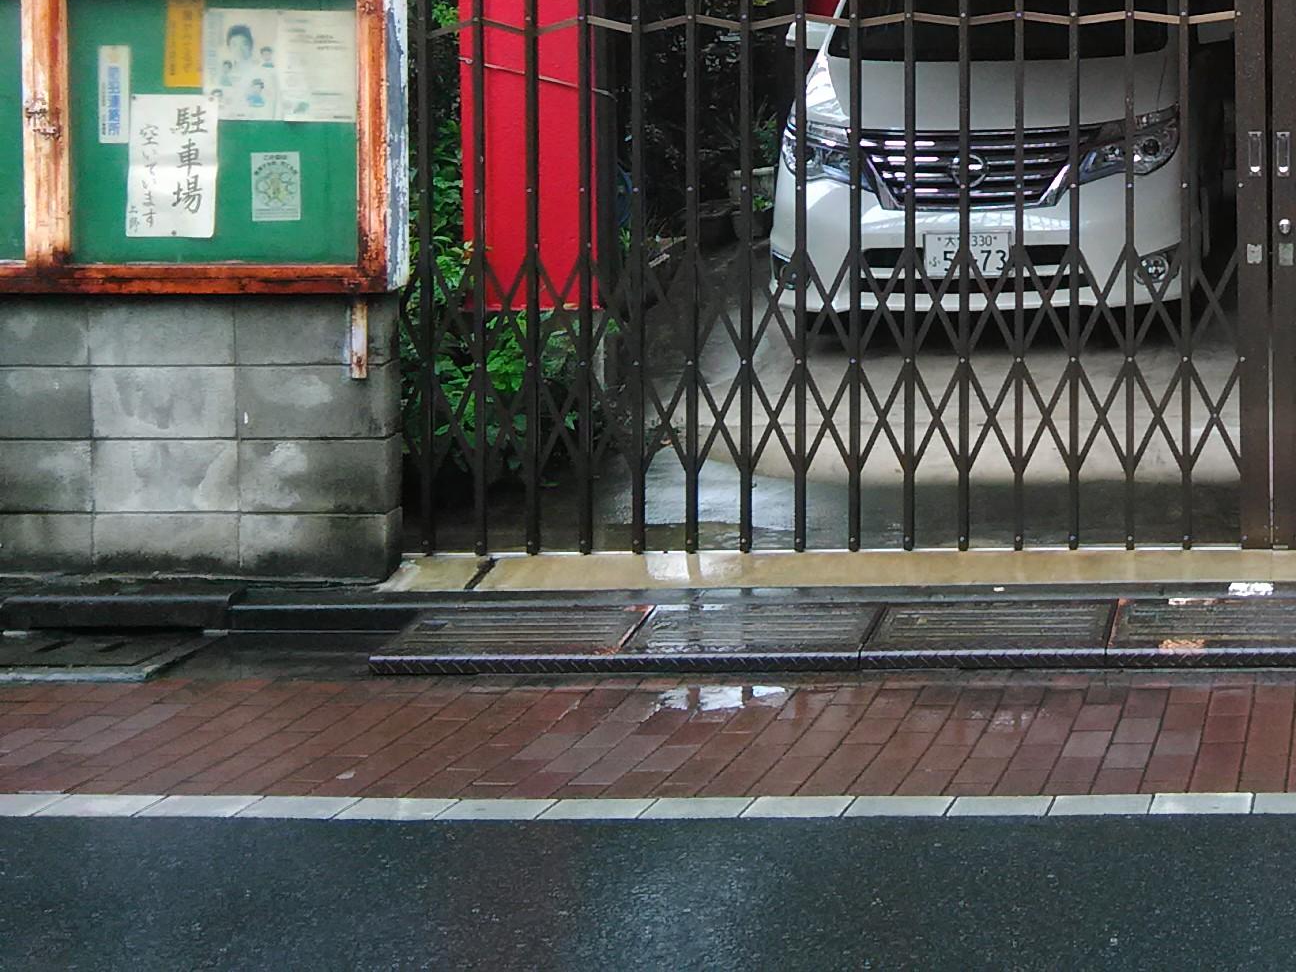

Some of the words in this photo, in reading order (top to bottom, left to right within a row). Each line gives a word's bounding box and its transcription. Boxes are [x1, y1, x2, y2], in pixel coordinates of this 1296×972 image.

[140, 124, 159, 228] 空いています
[170, 106, 208, 214] 駐車場
[971, 235, 993, 247] 330
